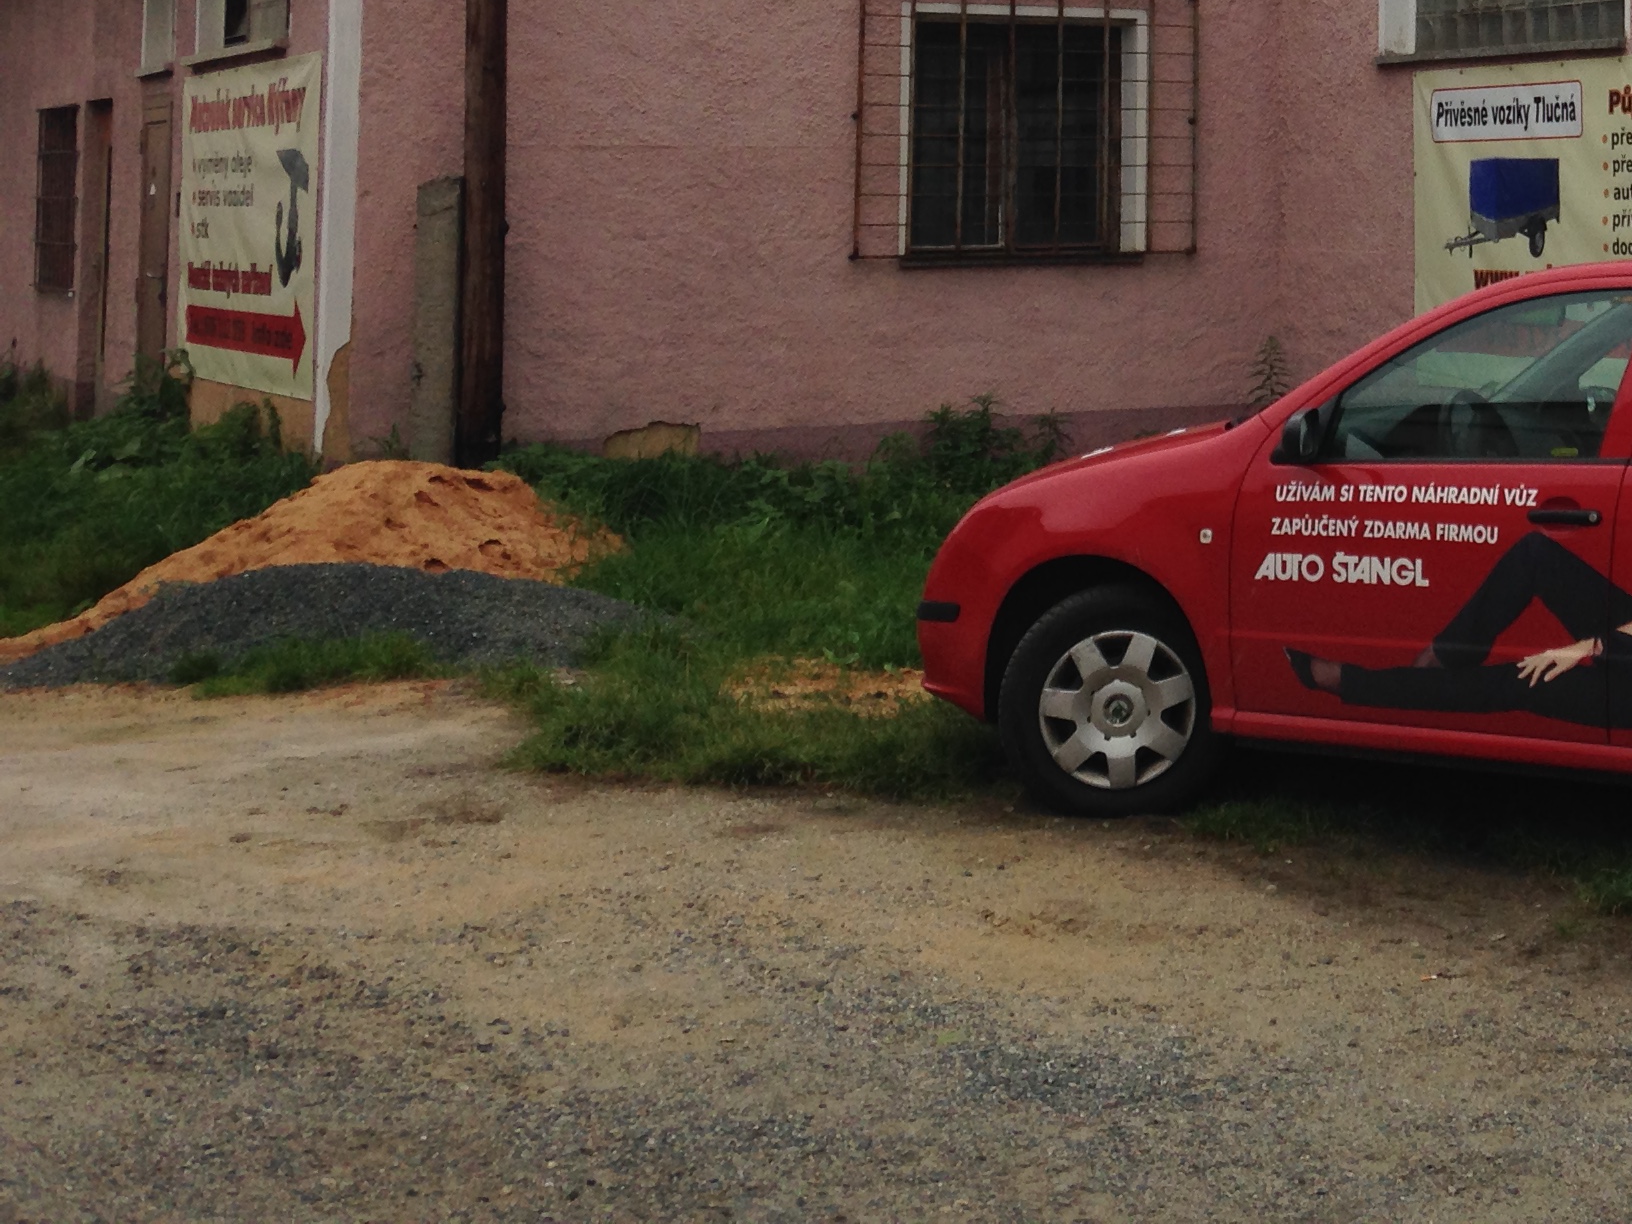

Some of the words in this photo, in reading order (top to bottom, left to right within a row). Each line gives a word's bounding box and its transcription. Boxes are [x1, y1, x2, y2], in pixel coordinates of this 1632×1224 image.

[1436, 97, 1488, 129] Přívěsné
[1490, 94, 1530, 131] vozíky
[1533, 92, 1577, 125] Tlučná
[1275, 480, 1335, 502] UŽÍVÁM
[1339, 484, 1355, 502] SI
[1359, 484, 1407, 503] TENTO
[1411, 481, 1501, 505] NÁHRADNÍ
[1504, 483, 1539, 507] VŮZ
[1271, 513, 1360, 537] ZAPŮJČENÝ
[1363, 520, 1431, 541] ZDARMA
[1436, 523, 1499, 545] FIRMOU
[1254, 552, 1325, 582] AUTO
[1332, 551, 1430, 587] ŠTANGL
